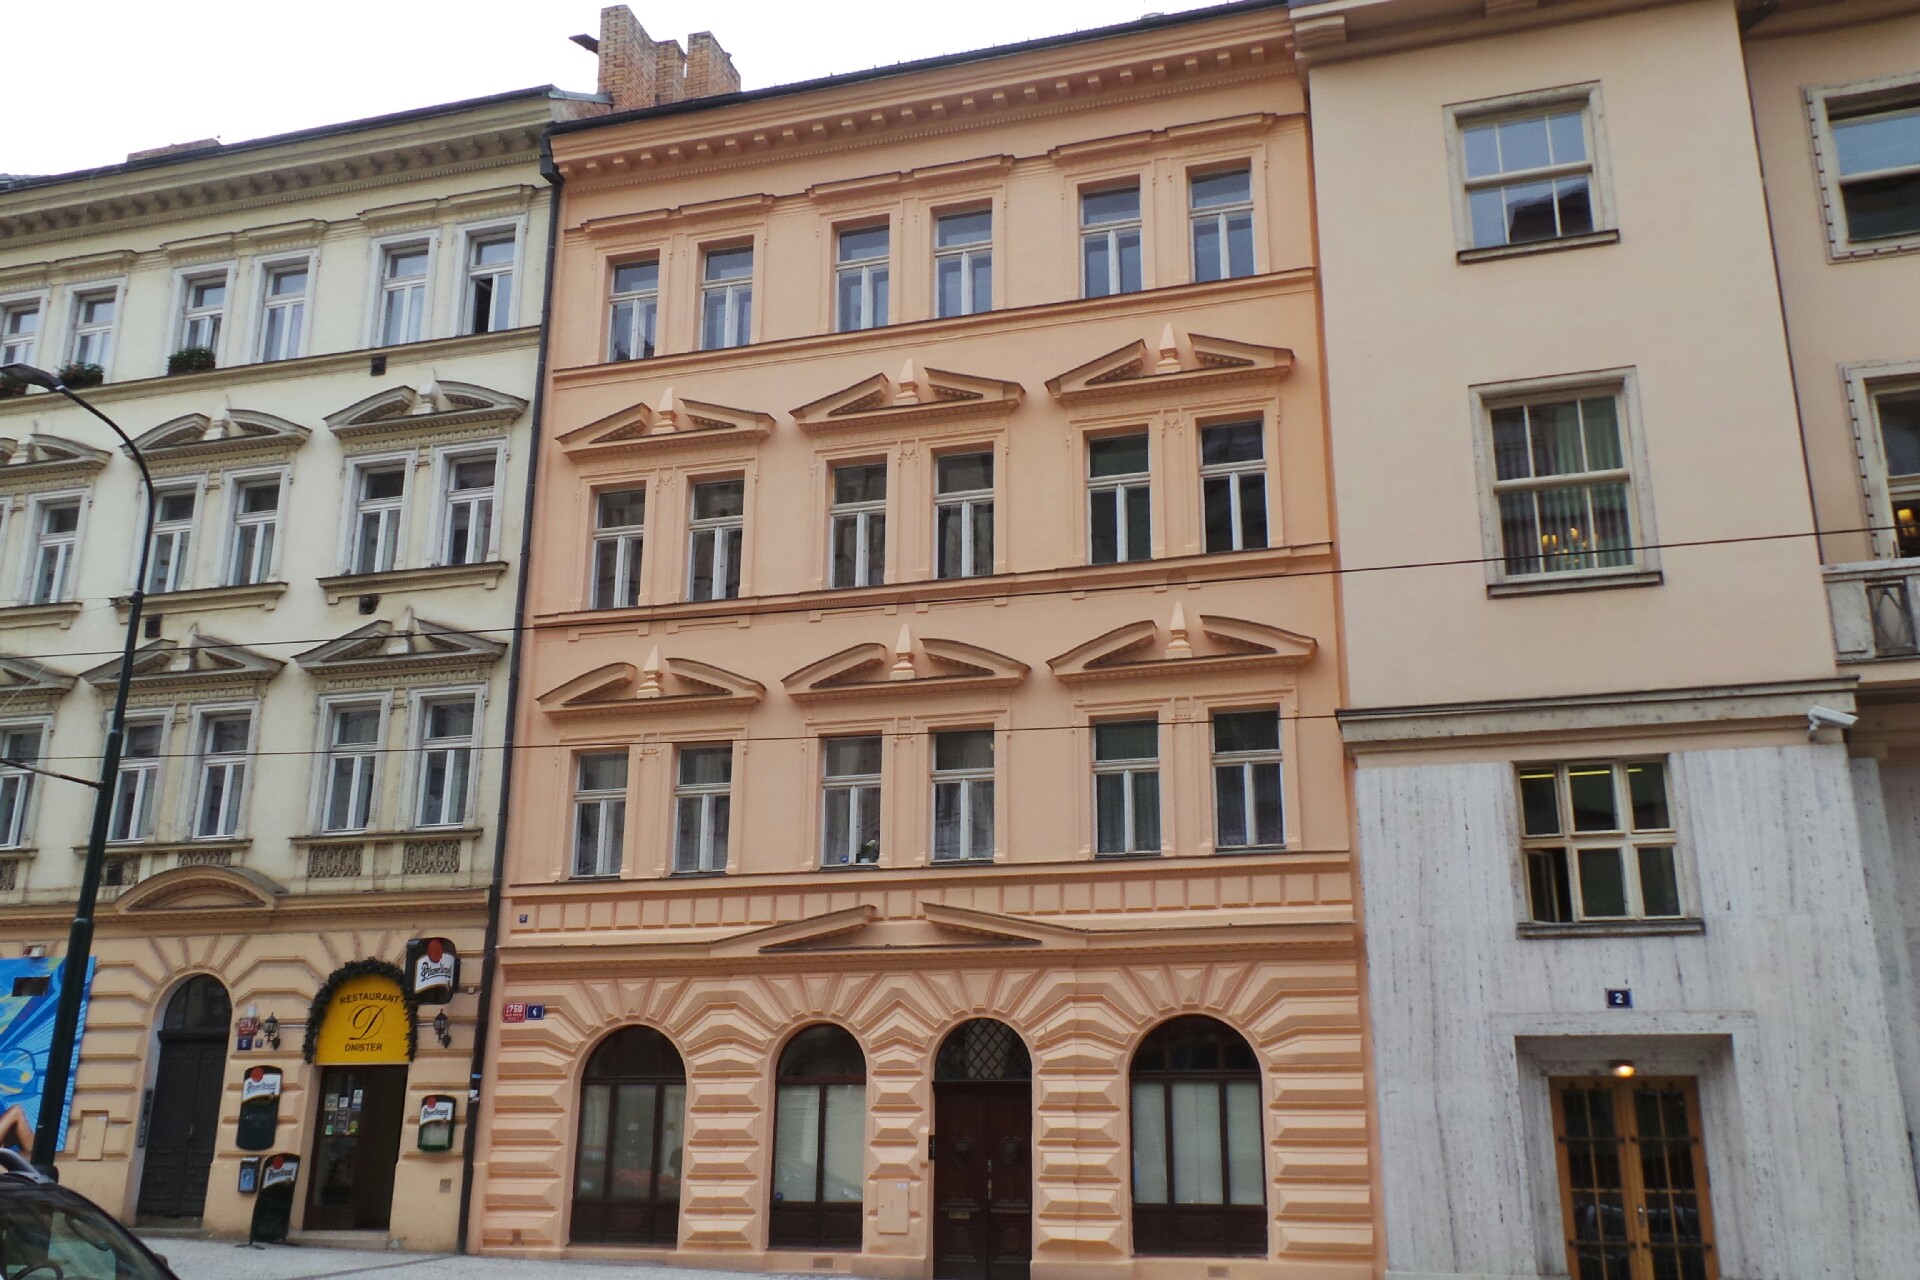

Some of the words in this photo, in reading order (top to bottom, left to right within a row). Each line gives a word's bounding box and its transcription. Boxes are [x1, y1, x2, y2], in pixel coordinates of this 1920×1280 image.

[340, 992, 400, 1005] RESTAURANT
[1614, 992, 1624, 1004] 2
[532, 1007, 538, 1016] 4
[344, 1042, 384, 1052] DNISTER
